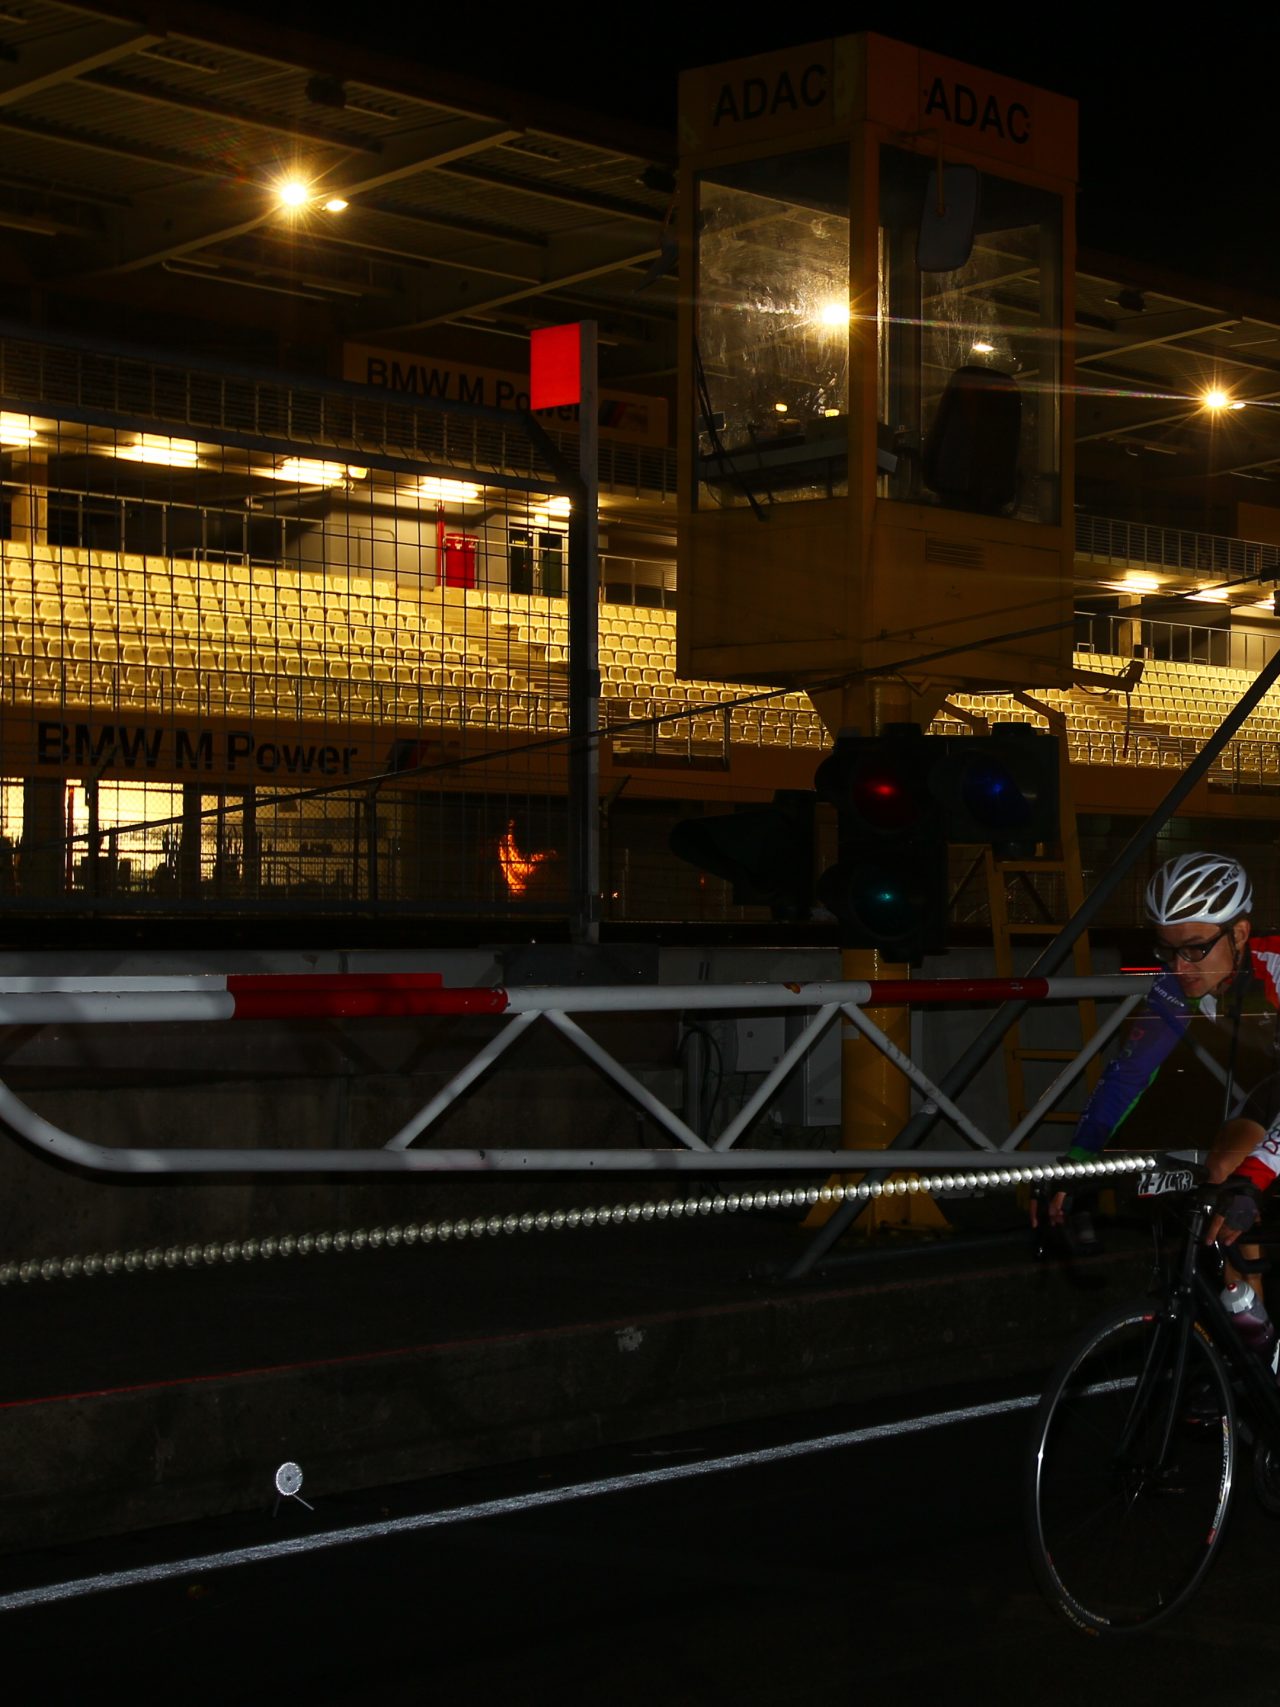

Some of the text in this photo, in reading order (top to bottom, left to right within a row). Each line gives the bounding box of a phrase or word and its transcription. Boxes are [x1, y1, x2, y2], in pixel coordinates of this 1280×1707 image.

[713, 64, 828, 127] ADAC
[924, 77, 1032, 144] ADAC
[367, 357, 450, 400] BMW
[458, 373, 484, 405] M
[37, 721, 358, 776] BMW M Power
